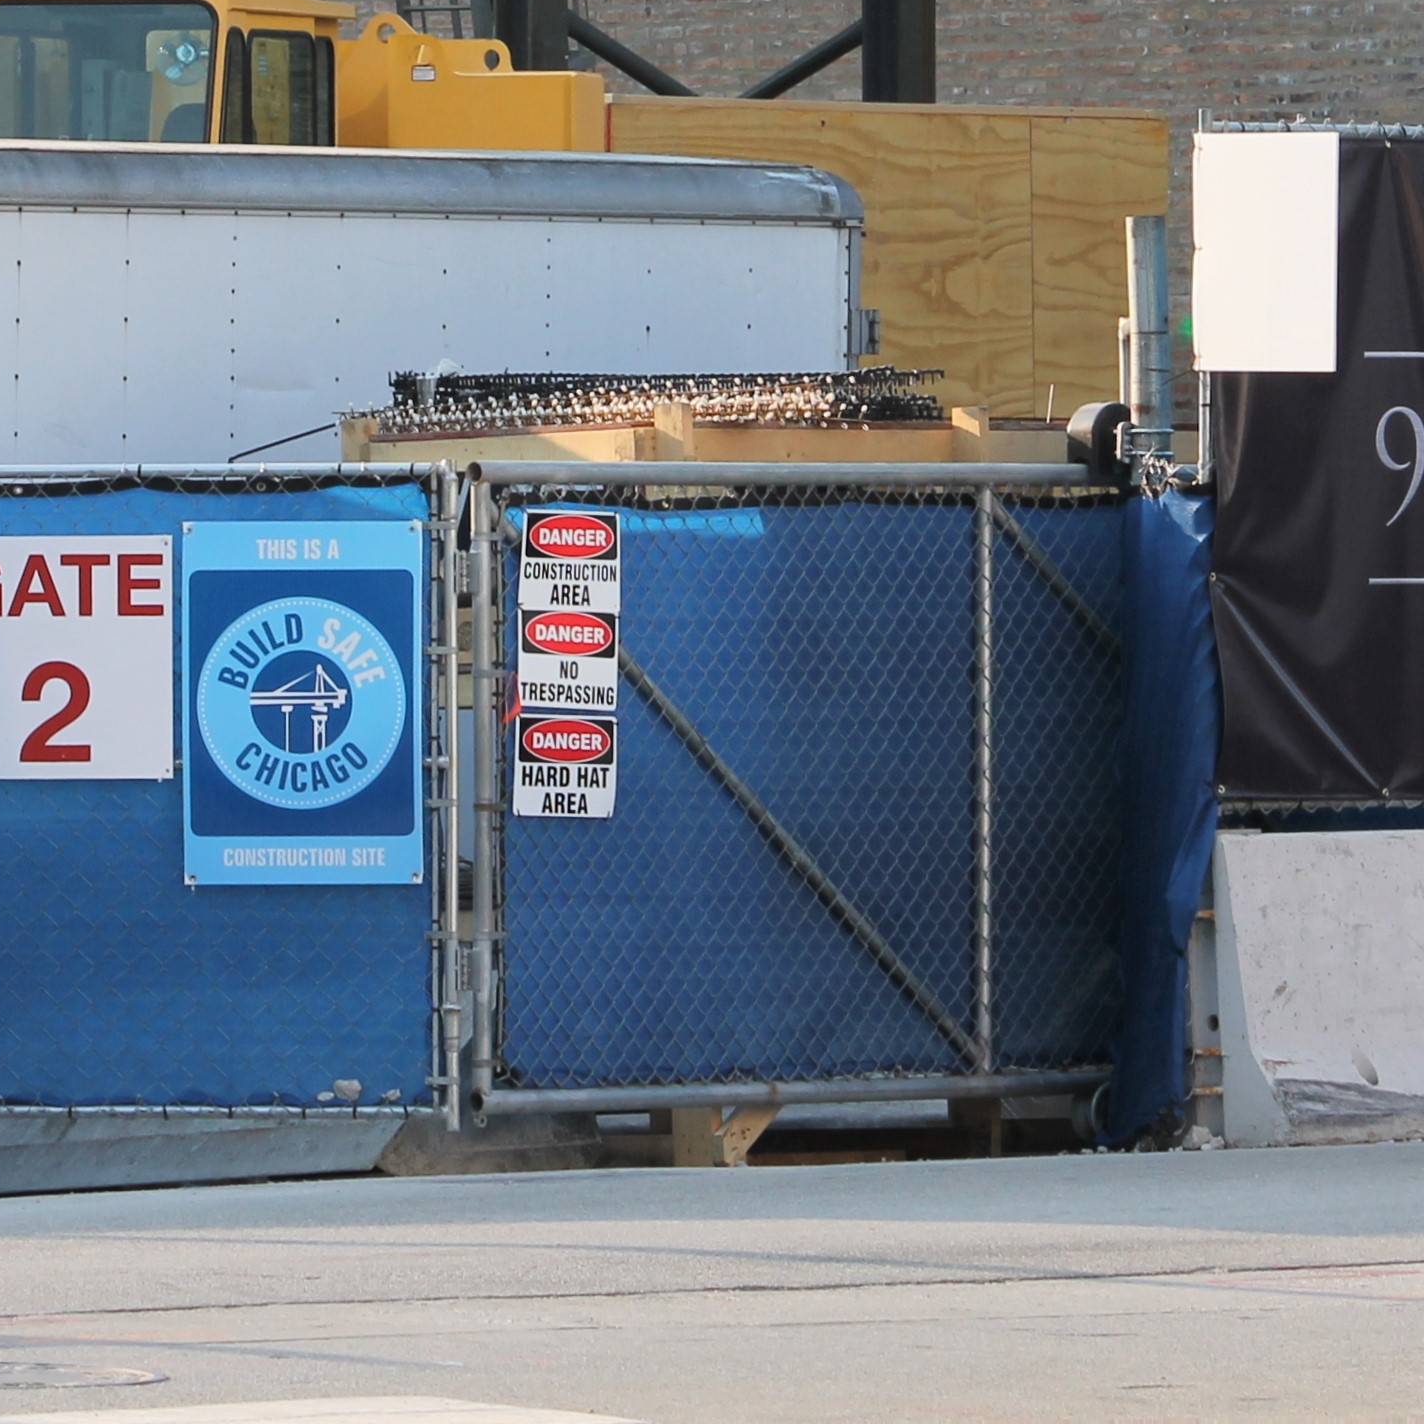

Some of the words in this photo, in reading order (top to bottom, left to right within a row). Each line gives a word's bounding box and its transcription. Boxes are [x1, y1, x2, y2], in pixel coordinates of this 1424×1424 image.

[538, 528, 607, 547] DANGER
[256, 539, 297, 560] THIS
[304, 539, 322, 560] IS
[327, 539, 340, 560] A
[524, 561, 617, 582] CONSTRUCTION
[550, 584, 591, 606] AREA
[534, 623, 605, 644] DANGER
[217, 613, 304, 690] BUILD
[316, 617, 386, 689] SAFE
[560, 660, 578, 679] NO
[520, 681, 614, 705] TRESPASSING
[19, 660, 92, 763] 2
[532, 731, 603, 751] DANGER
[235, 741, 369, 793] CHICAGO
[522, 765, 570, 787] HARD
[577, 767, 609, 789] HAT
[541, 792, 589, 814] AREA
[223, 847, 346, 867] CONSTRUCTION
[351, 847, 386, 866] SITE
